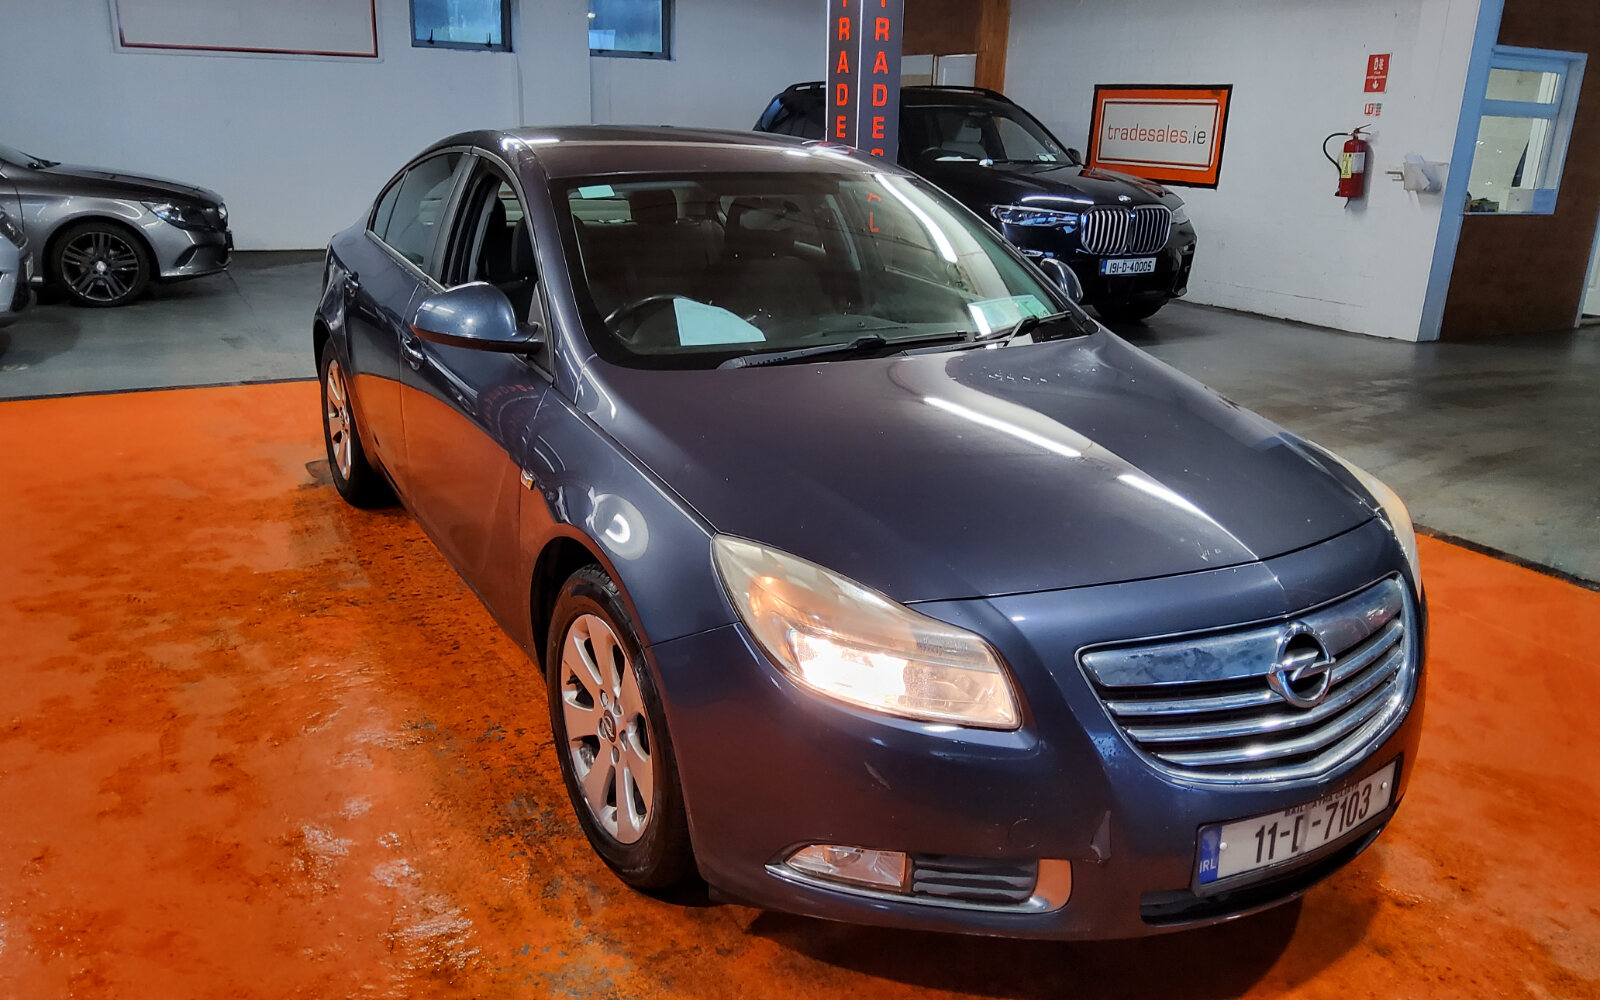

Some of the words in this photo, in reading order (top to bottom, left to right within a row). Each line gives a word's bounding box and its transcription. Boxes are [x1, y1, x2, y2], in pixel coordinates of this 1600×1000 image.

[1107, 122, 1206, 145] tradesales.ie
[1109, 260, 1153, 273] 191-D-40005
[1199, 858, 1217, 874] IRL
